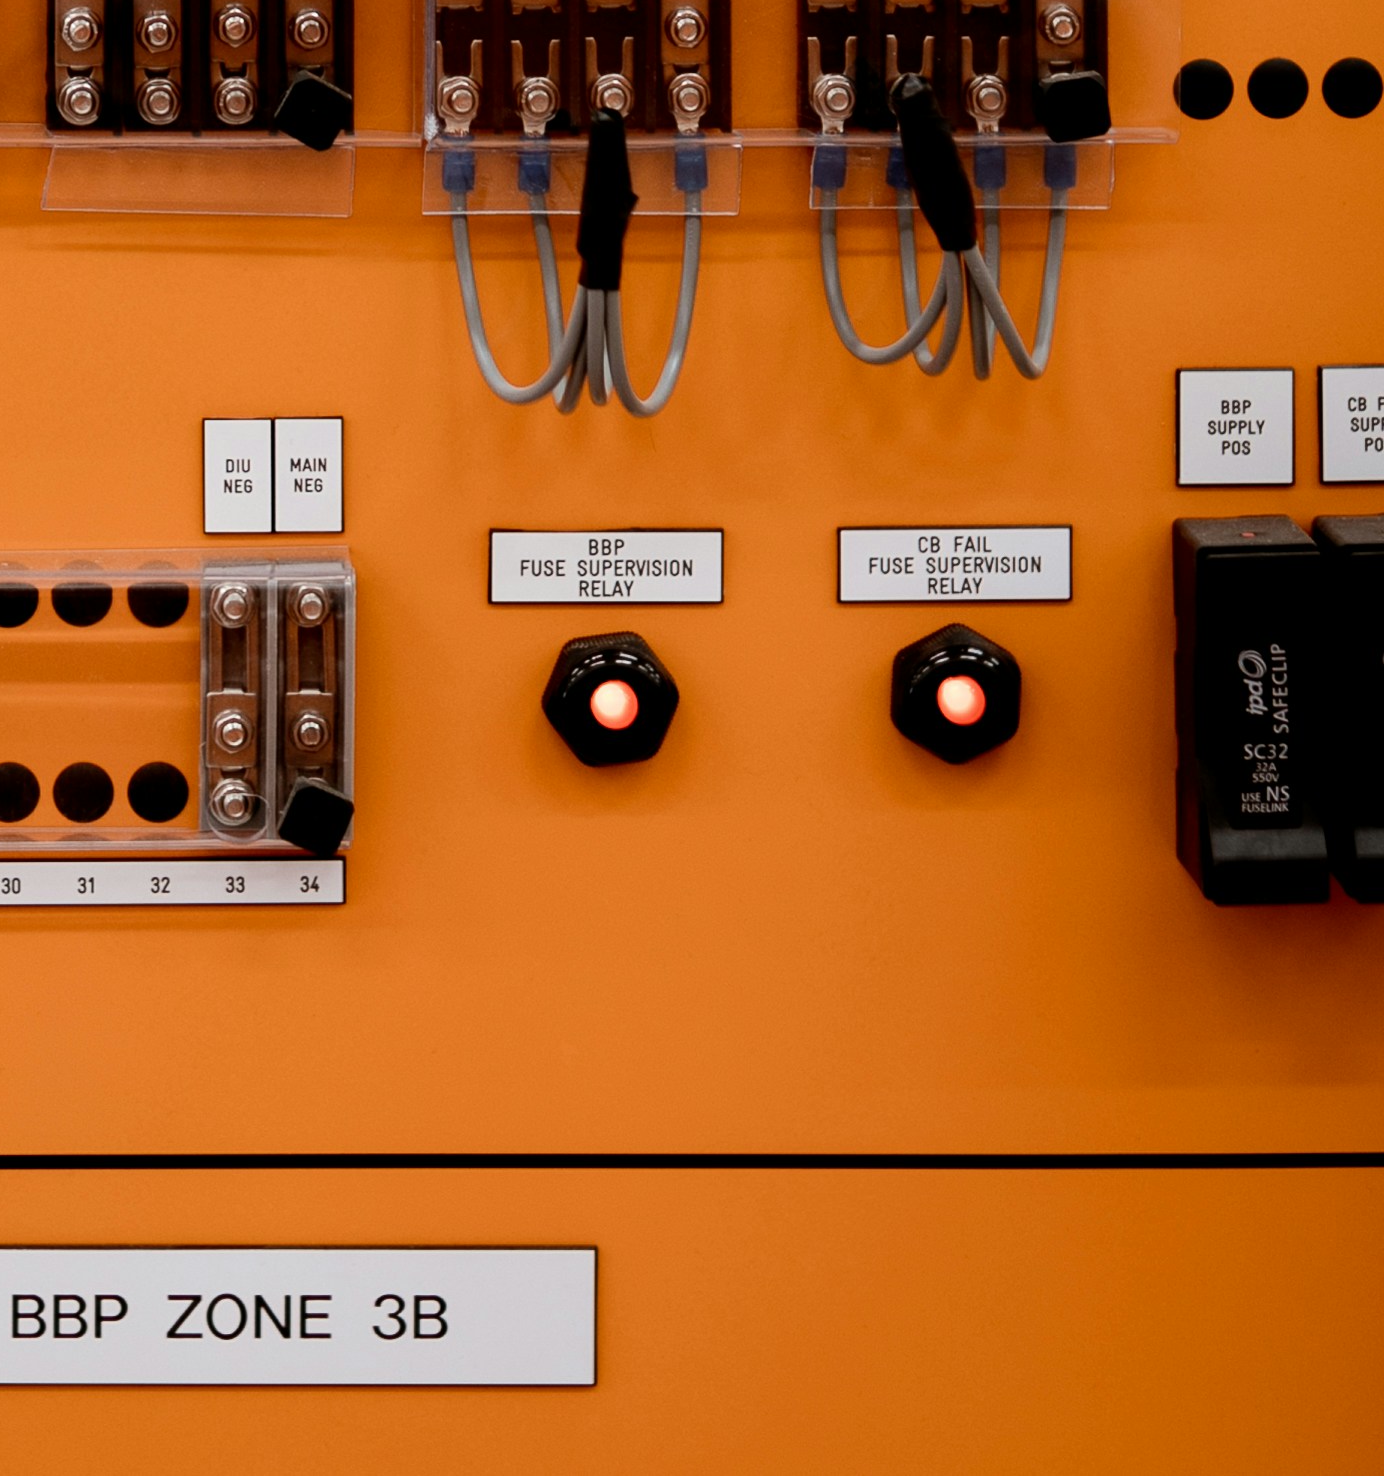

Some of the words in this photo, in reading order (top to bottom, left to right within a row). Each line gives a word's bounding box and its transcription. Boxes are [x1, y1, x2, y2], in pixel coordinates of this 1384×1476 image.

[1220, 399, 1252, 415] BBP
[1207, 419, 1265, 436] SUPPLY
[1221, 440, 1251, 456] POS
[225, 458, 251, 474] DIU
[290, 457, 327, 472] MAIN
[223, 478, 253, 494] NEG
[294, 477, 323, 493] NEG
[588, 538, 625, 557] BBP
[917, 535, 941, 554] CB
[953, 535, 992, 553] FAIL
[520, 559, 566, 577] FUSE
[577, 559, 693, 577] SUPERVISION
[868, 556, 915, 575] FUSE
[925, 555, 1042, 575] SUPERVISION
[579, 579, 634, 598] RELAY
[927, 577, 983, 595] RELAY
[1243, 678, 1268, 715] ipd
[1270, 643, 1289, 734] SAFECLIP
[1243, 743, 1289, 760] SC32
[1241, 792, 1261, 803] USE
[1266, 785, 1290, 802] NS
[1241, 802, 1289, 813] FUSELINK
[1, 877, 21, 895] 30
[77, 876, 95, 895] 31
[150, 876, 171, 894] 32
[225, 875, 246, 894] 33
[299, 875, 320, 894] 34
[11, 1294, 129, 1339] BBP
[166, 1293, 333, 1341] ZONE
[372, 1293, 448, 1341] 3B
